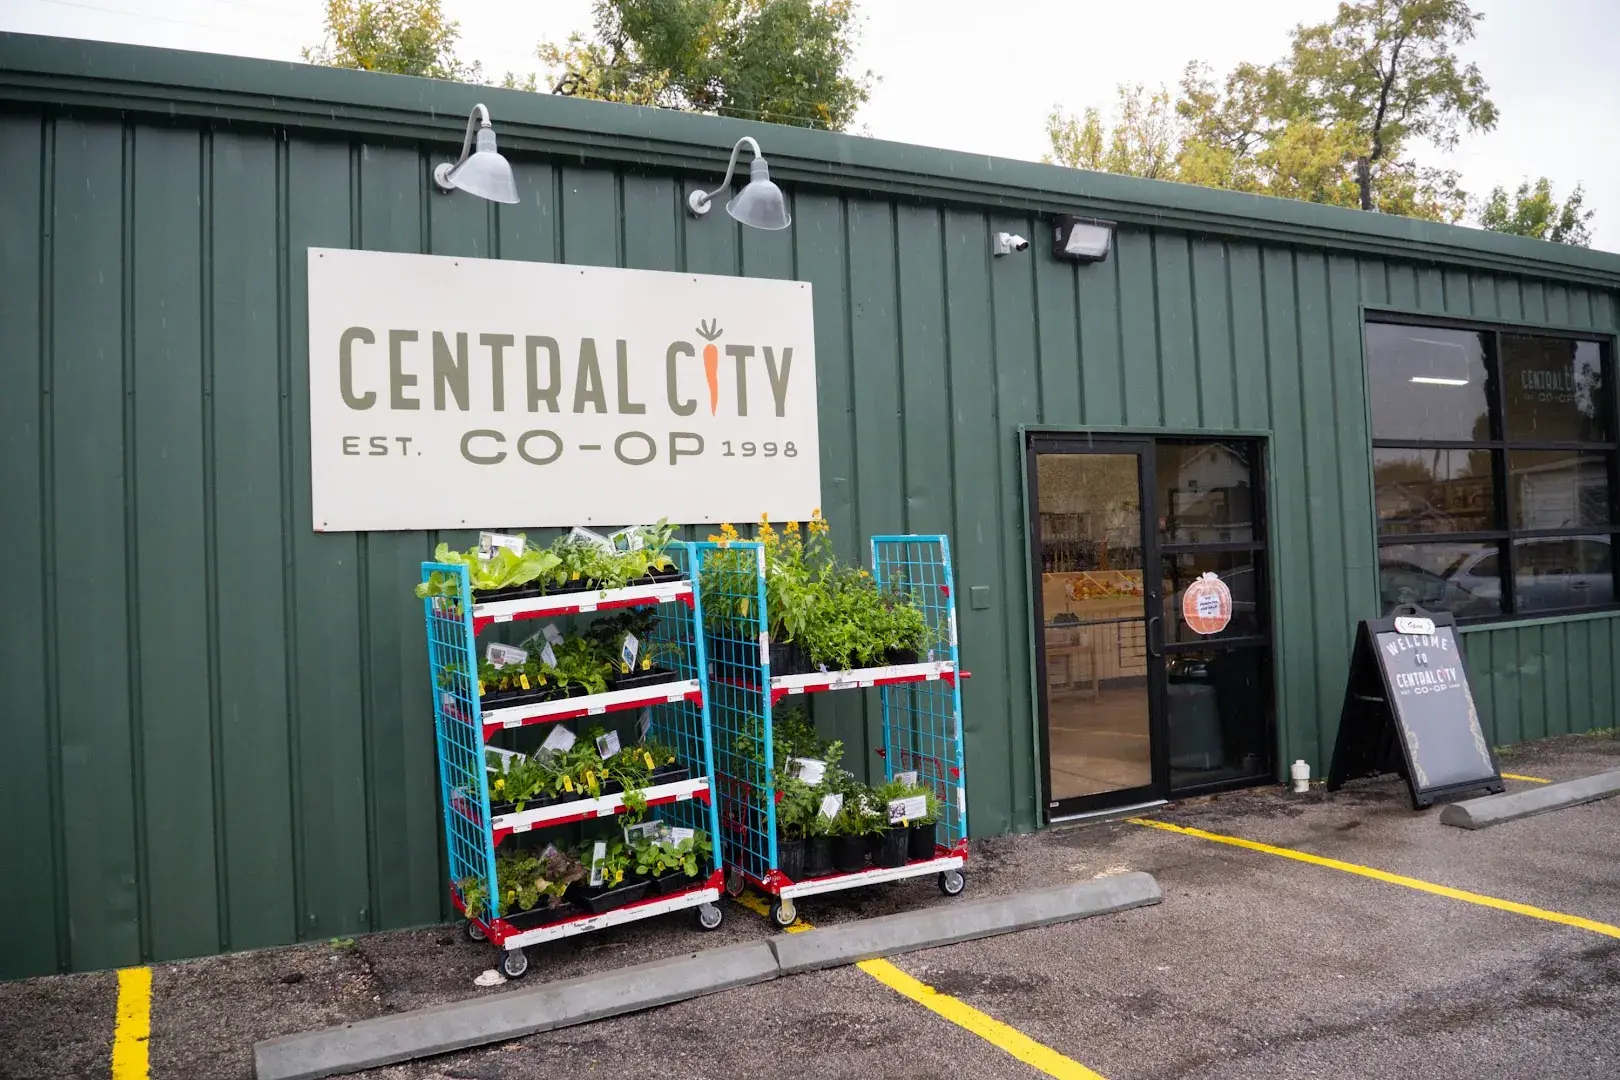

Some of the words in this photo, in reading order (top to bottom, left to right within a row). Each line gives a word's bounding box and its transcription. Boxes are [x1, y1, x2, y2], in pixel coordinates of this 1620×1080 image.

[339, 326, 646, 415] CENTRAL
[665, 318, 793, 417] CITY
[1521, 369, 1564, 391] CENTRAL
[342, 436, 422, 457] EST.
[460, 429, 705, 466] CO-OP
[722, 440, 799, 459] 1998
[1386, 635, 1447, 656] WELCOME
[1415, 652, 1428, 664] TO
[1396, 670, 1437, 688] CENTRAL
[1414, 685, 1447, 694] CO-OP
